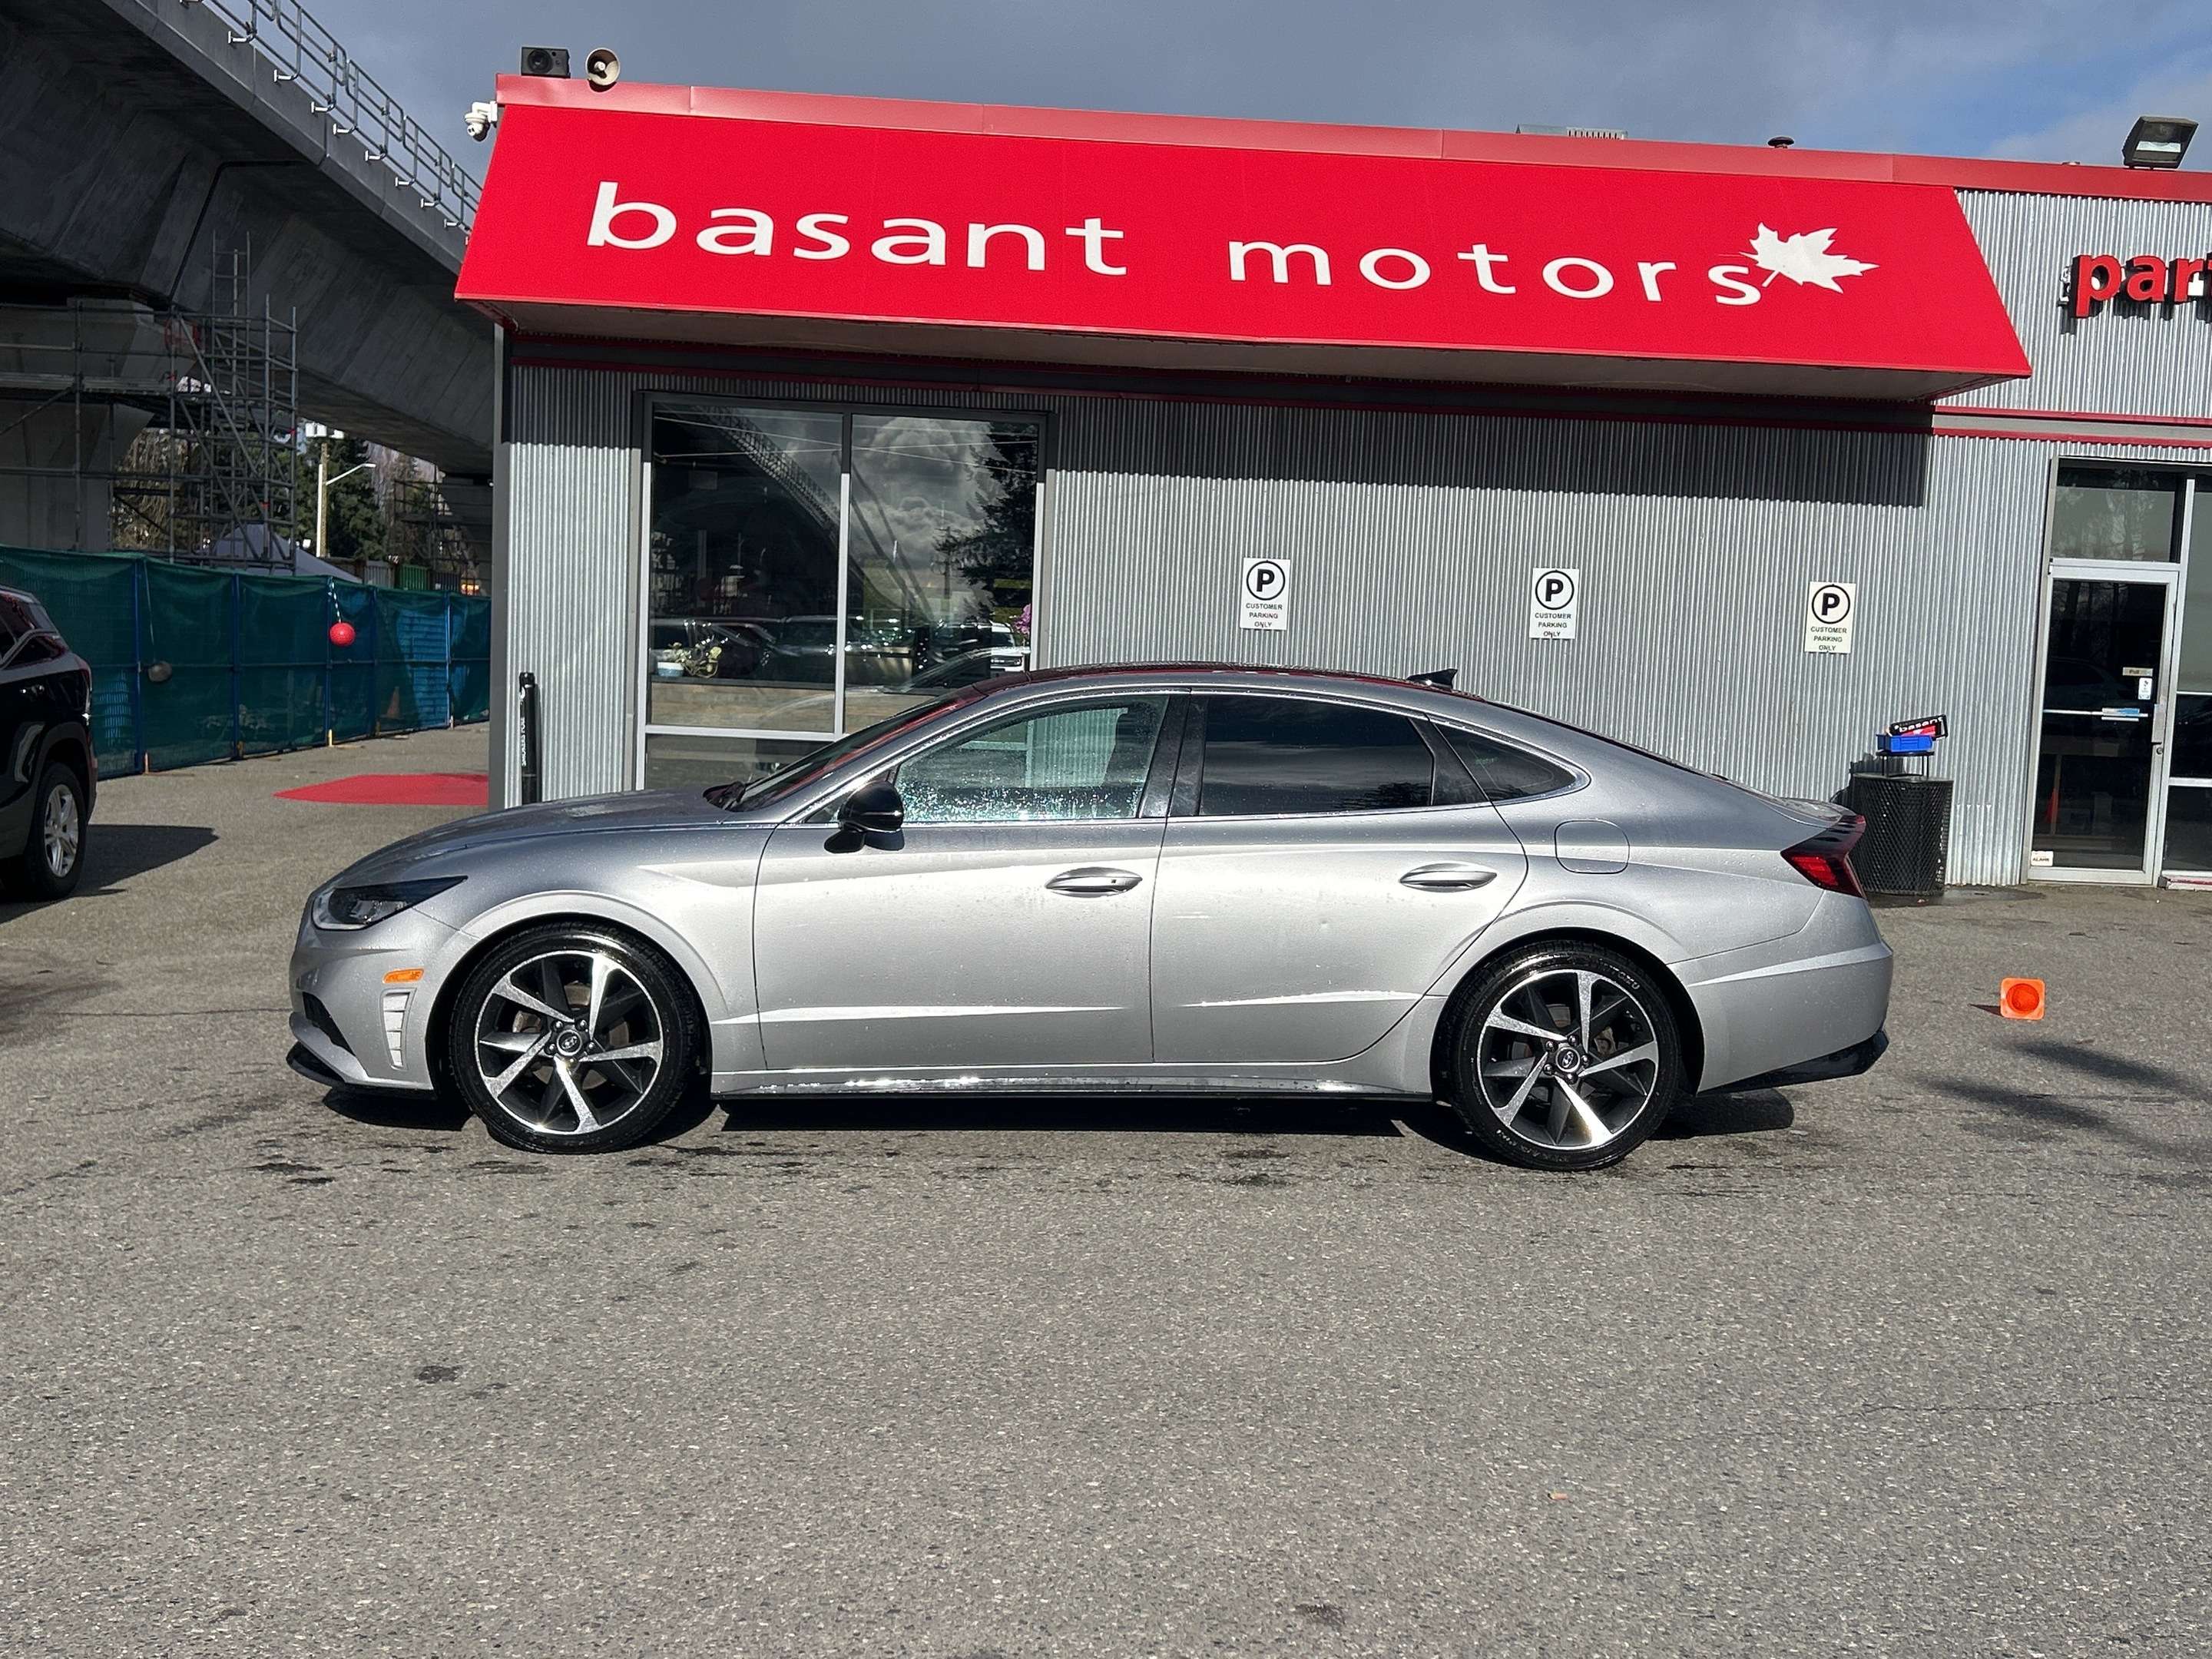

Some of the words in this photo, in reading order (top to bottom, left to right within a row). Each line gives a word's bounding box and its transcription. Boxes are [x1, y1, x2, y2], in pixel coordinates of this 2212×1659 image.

[587, 181, 1128, 276] basant
[1229, 241, 1761, 306] motors
[2073, 253, 2212, 320] par
[1257, 568, 1275, 592] P
[1545, 578, 1564, 602] P
[1821, 592, 1840, 616] P
